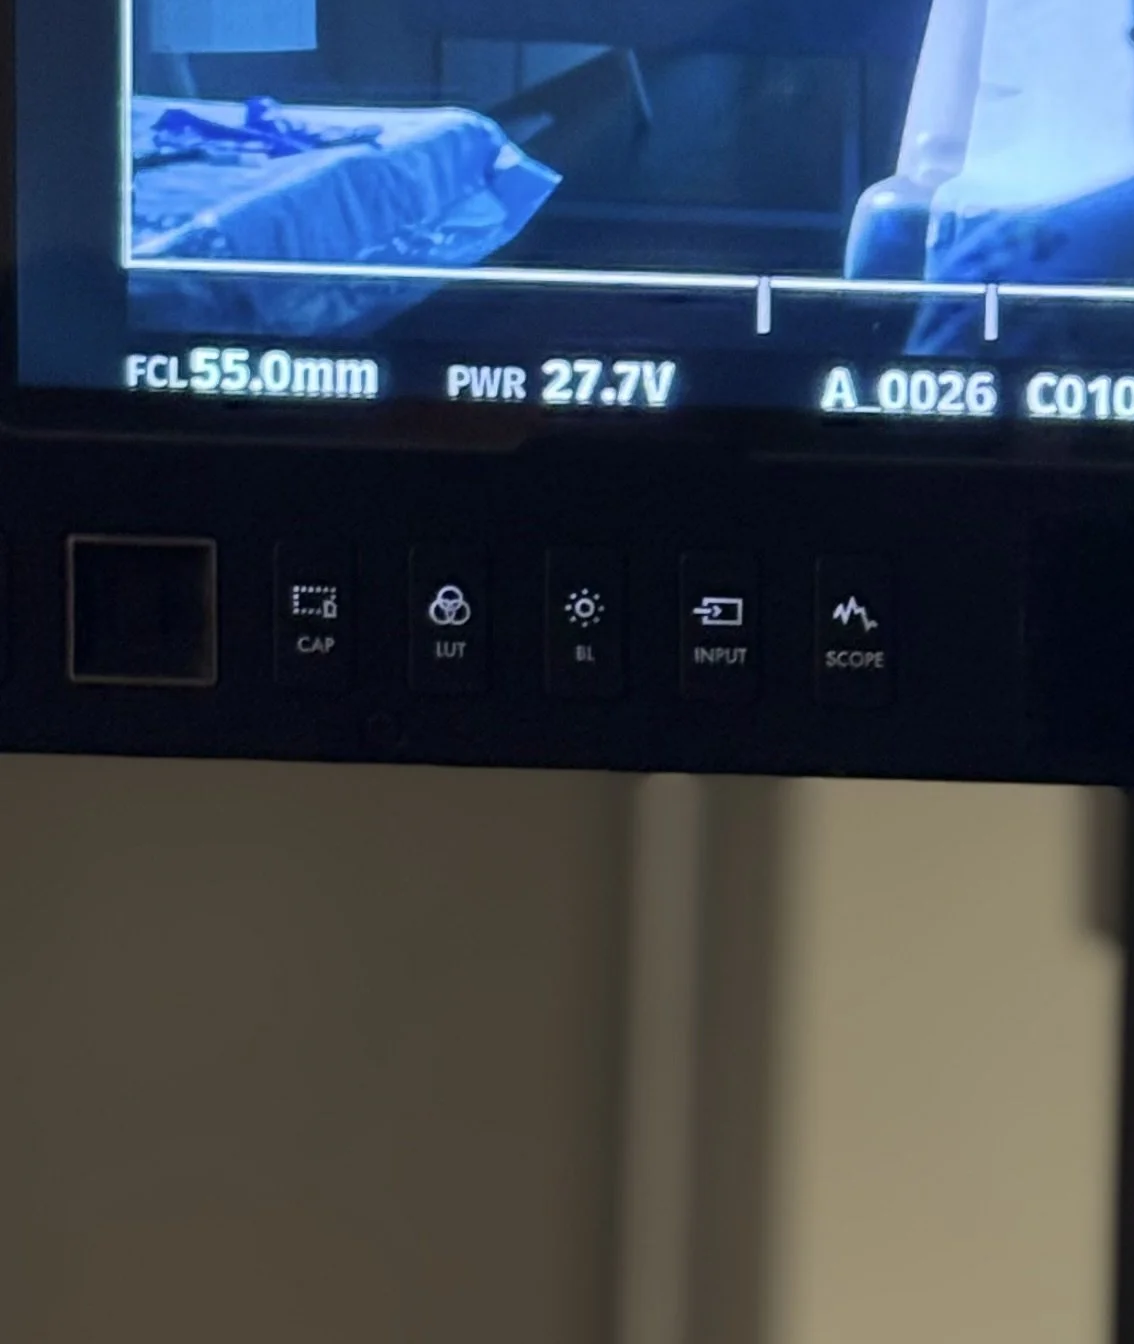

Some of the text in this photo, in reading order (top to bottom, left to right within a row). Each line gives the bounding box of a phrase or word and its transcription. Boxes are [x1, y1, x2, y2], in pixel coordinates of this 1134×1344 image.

[126, 348, 379, 398] FCL 55.0mm
[447, 359, 675, 406] PWR 27.7V
[819, 367, 997, 414] A_0026
[297, 635, 335, 654] CAP
[435, 641, 466, 659] LUT
[694, 647, 748, 665] INPUT
[825, 652, 885, 669] SCOPE
